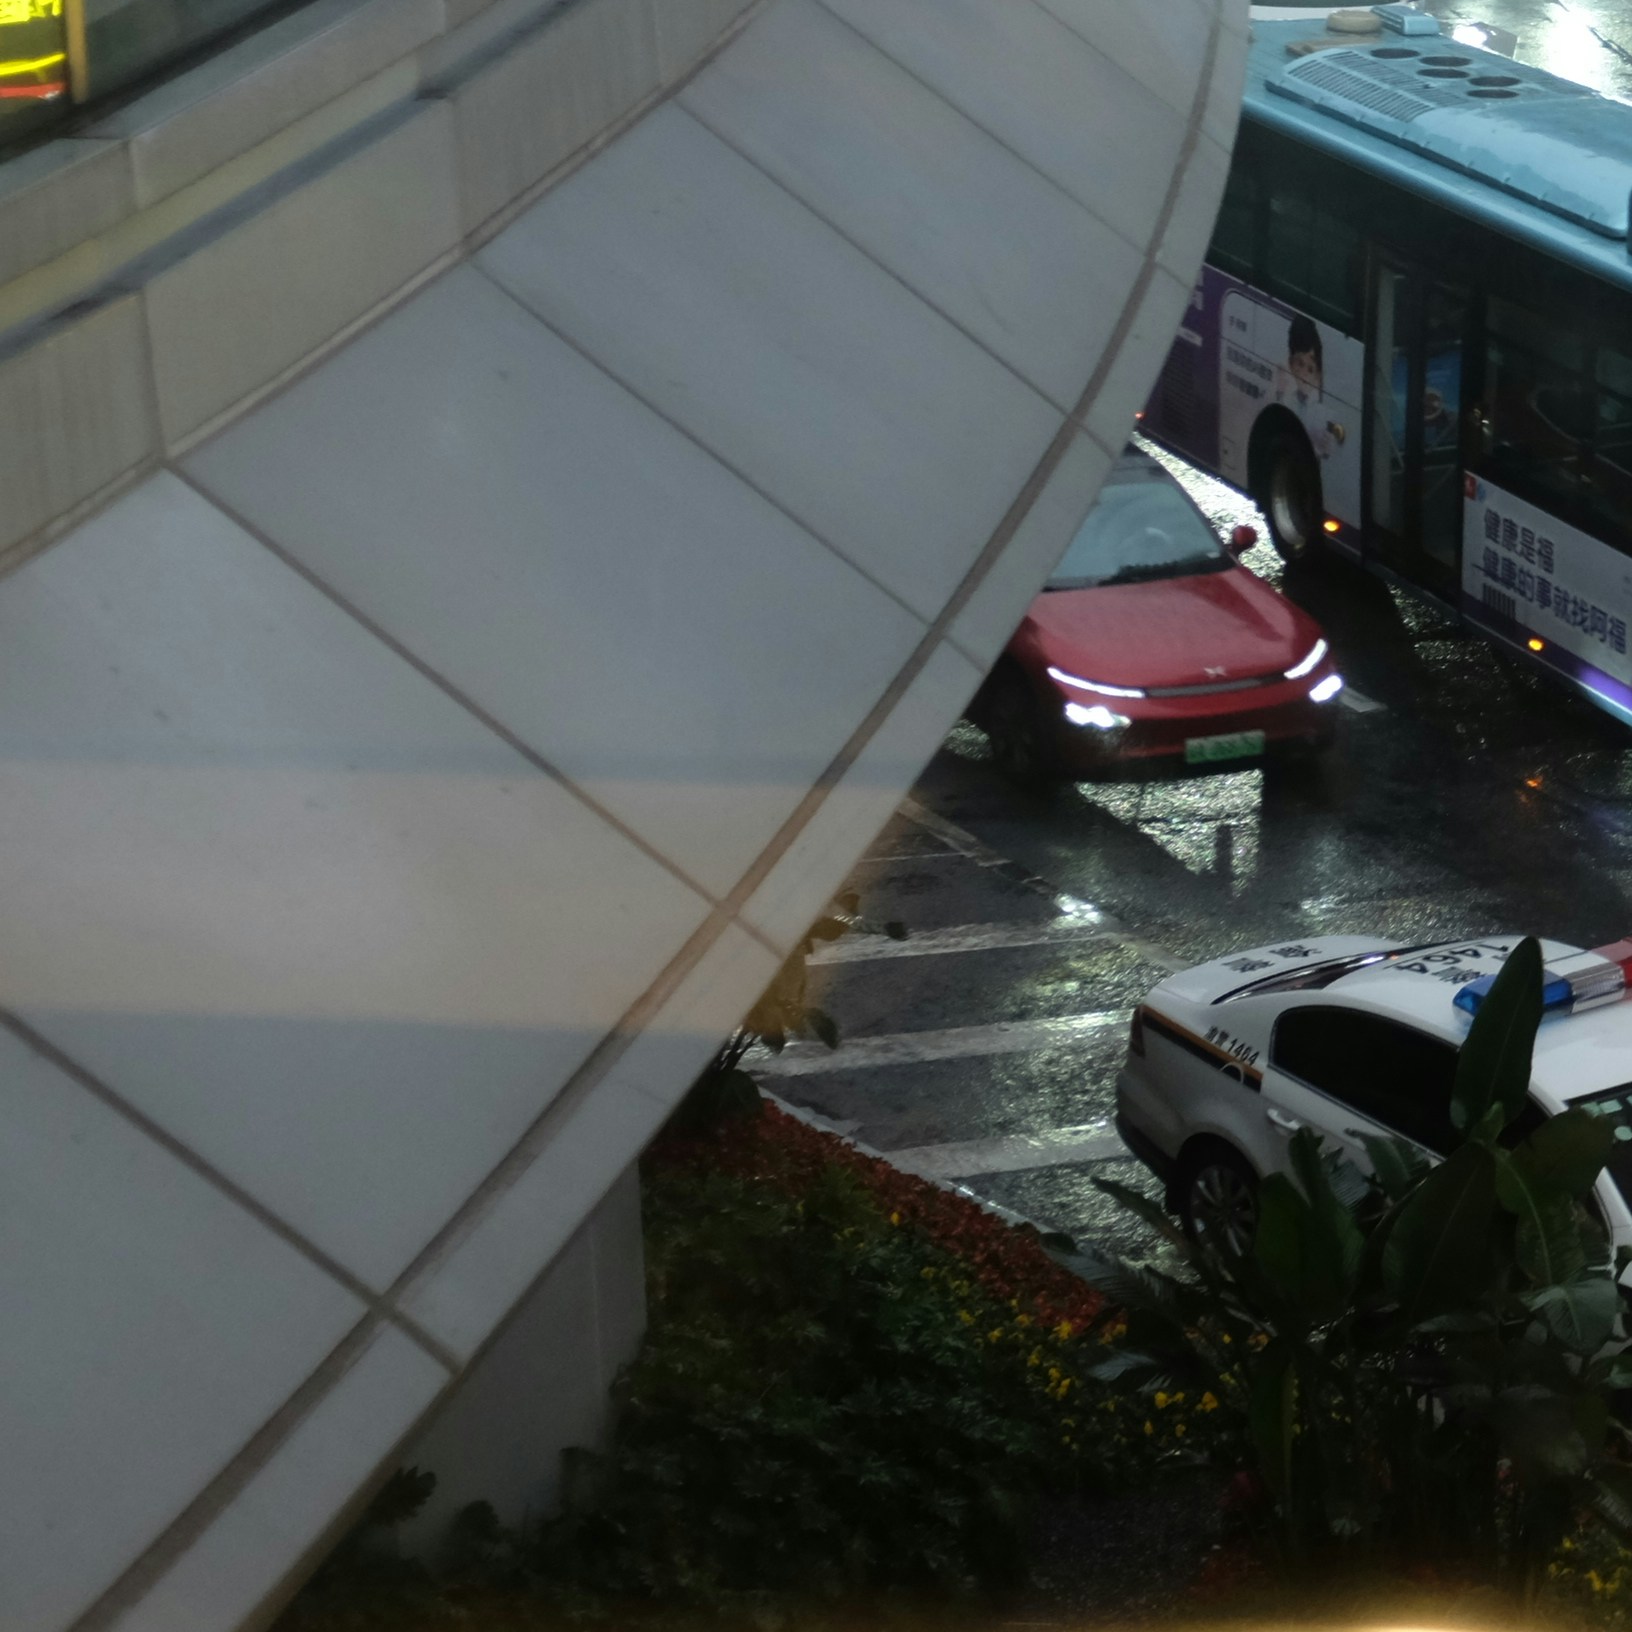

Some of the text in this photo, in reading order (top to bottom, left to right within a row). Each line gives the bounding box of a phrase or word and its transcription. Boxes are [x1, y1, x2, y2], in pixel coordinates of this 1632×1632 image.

[1484, 507, 1555, 575] 健康是福
[1482, 546, 1627, 655] 健康的事就找阿福
